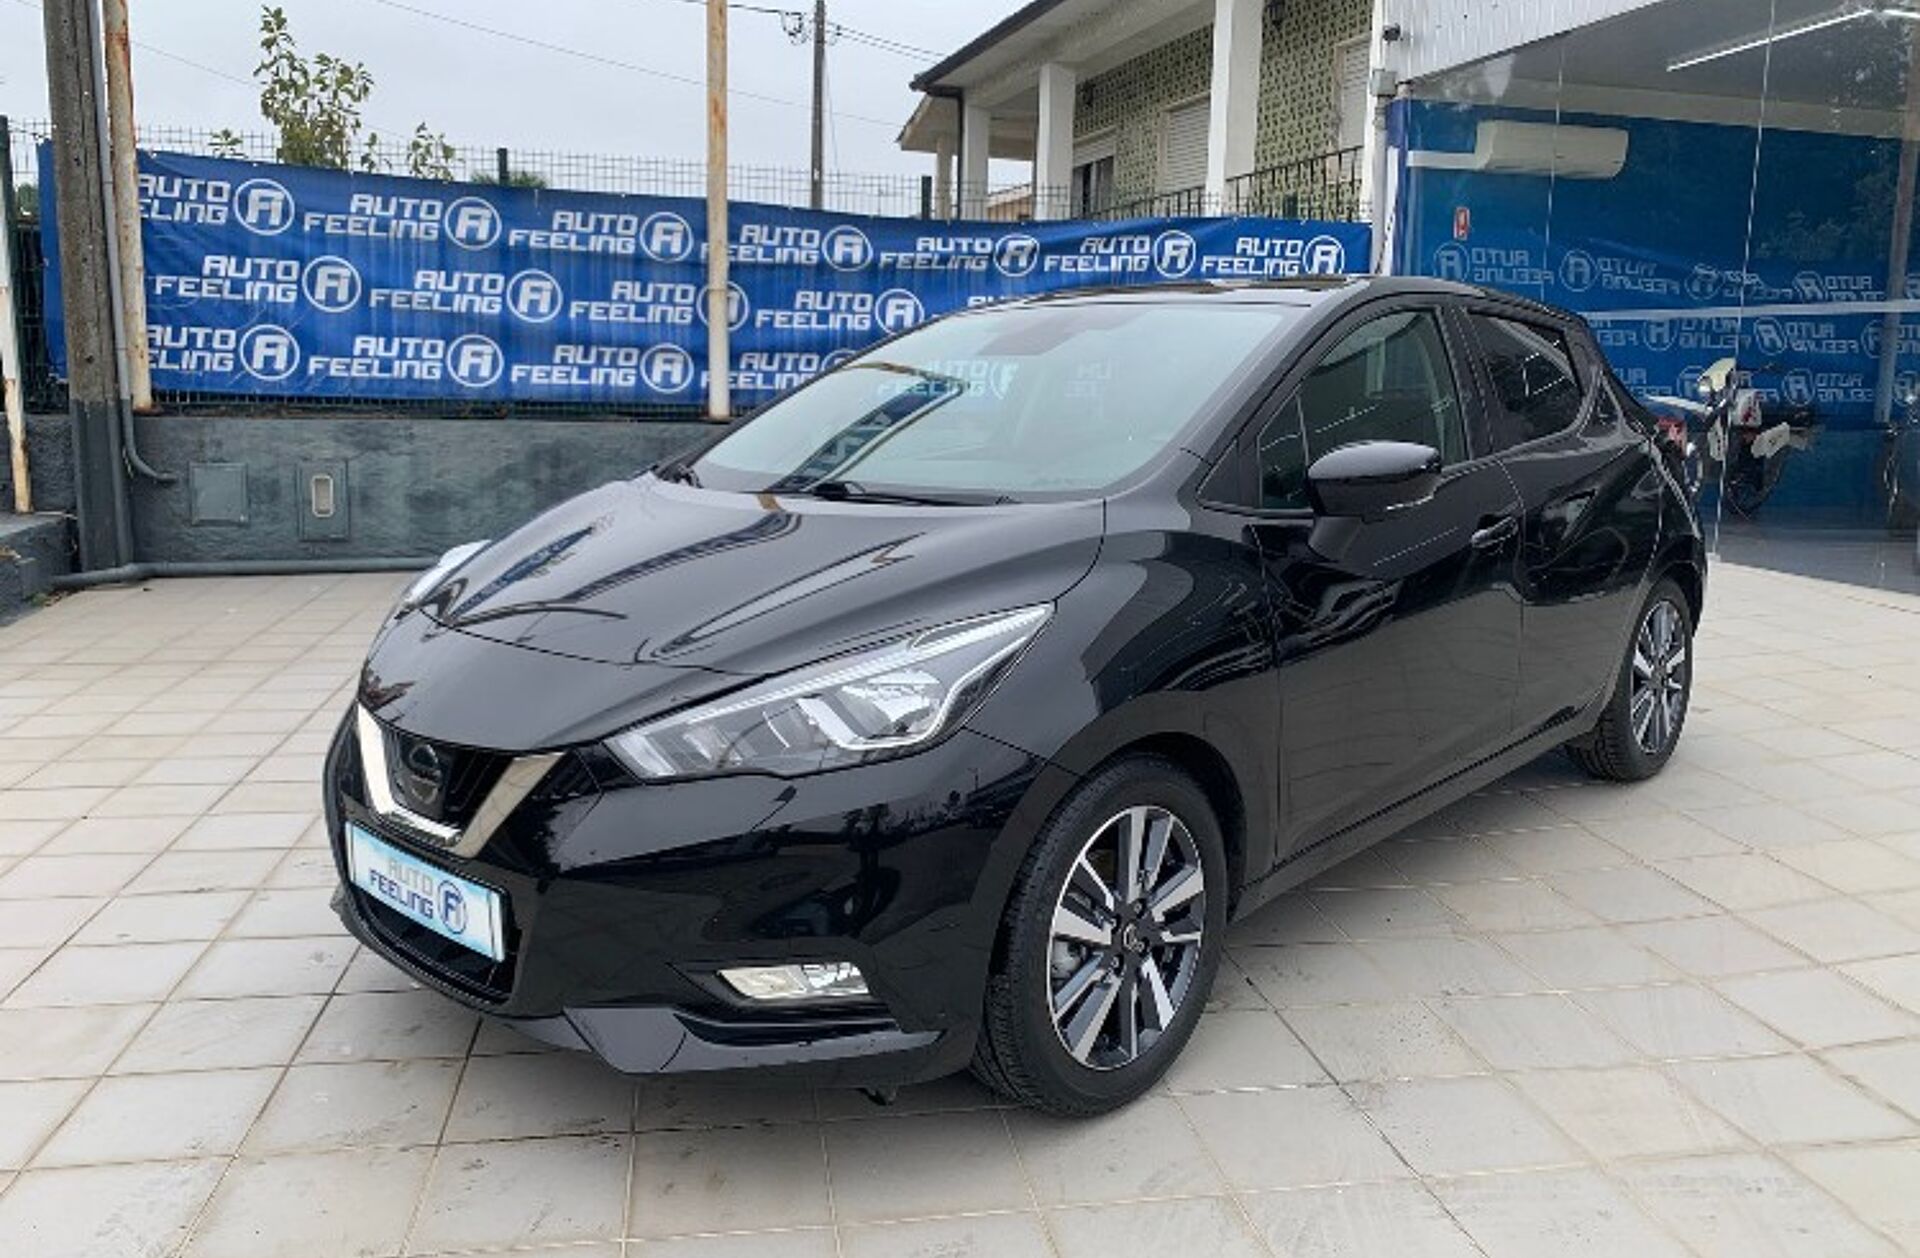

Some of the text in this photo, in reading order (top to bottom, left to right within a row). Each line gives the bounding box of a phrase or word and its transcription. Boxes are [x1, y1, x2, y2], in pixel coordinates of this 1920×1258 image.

[350, 193, 443, 220] AUTO
[304, 212, 440, 240] FEELING
[553, 210, 638, 236] AUTO
[508, 229, 635, 254] FEELING
[740, 224, 820, 249] AUTO
[916, 237, 993, 253] AUTO
[1080, 235, 1150, 254] AUTO
[1236, 237, 1304, 257] AUTO
[202, 255, 299, 280] AUTO
[879, 252, 989, 270] FEELING
[1044, 255, 1150, 272] FEELING
[1201, 255, 1302, 275] FEELING
[155, 275, 298, 303] FEELING
[415, 270, 505, 294] AUTO
[611, 280, 696, 304] AUTO
[369, 288, 501, 314] FEELING
[569, 301, 693, 325] FEELING
[795, 291, 873, 313] AUTO
[755, 309, 871, 331] FEELING
[353, 335, 446, 359] AUTO
[554, 344, 640, 367] AUTO
[307, 356, 444, 380] FEELING
[739, 352, 820, 372] AUTO
[511, 365, 637, 387] FEELING
[388, 858, 434, 896] AUTO
[369, 868, 434, 919] FEELING
